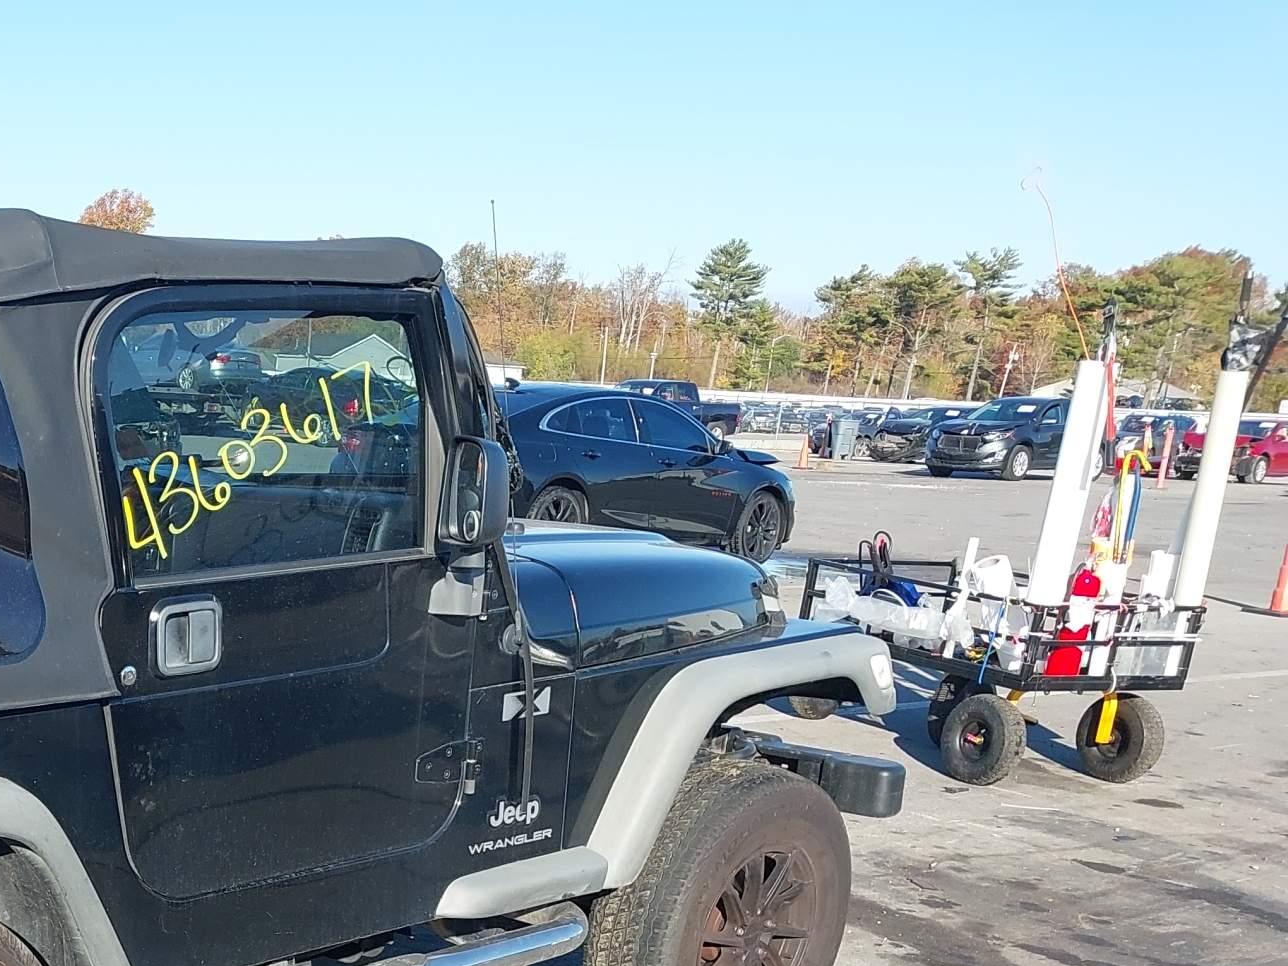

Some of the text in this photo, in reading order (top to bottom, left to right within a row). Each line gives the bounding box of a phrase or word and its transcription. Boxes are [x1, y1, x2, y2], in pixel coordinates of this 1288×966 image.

[123, 361, 374, 559] 43603617
[489, 800, 539, 827] Jeep
[468, 828, 553, 854] WRANGLER
